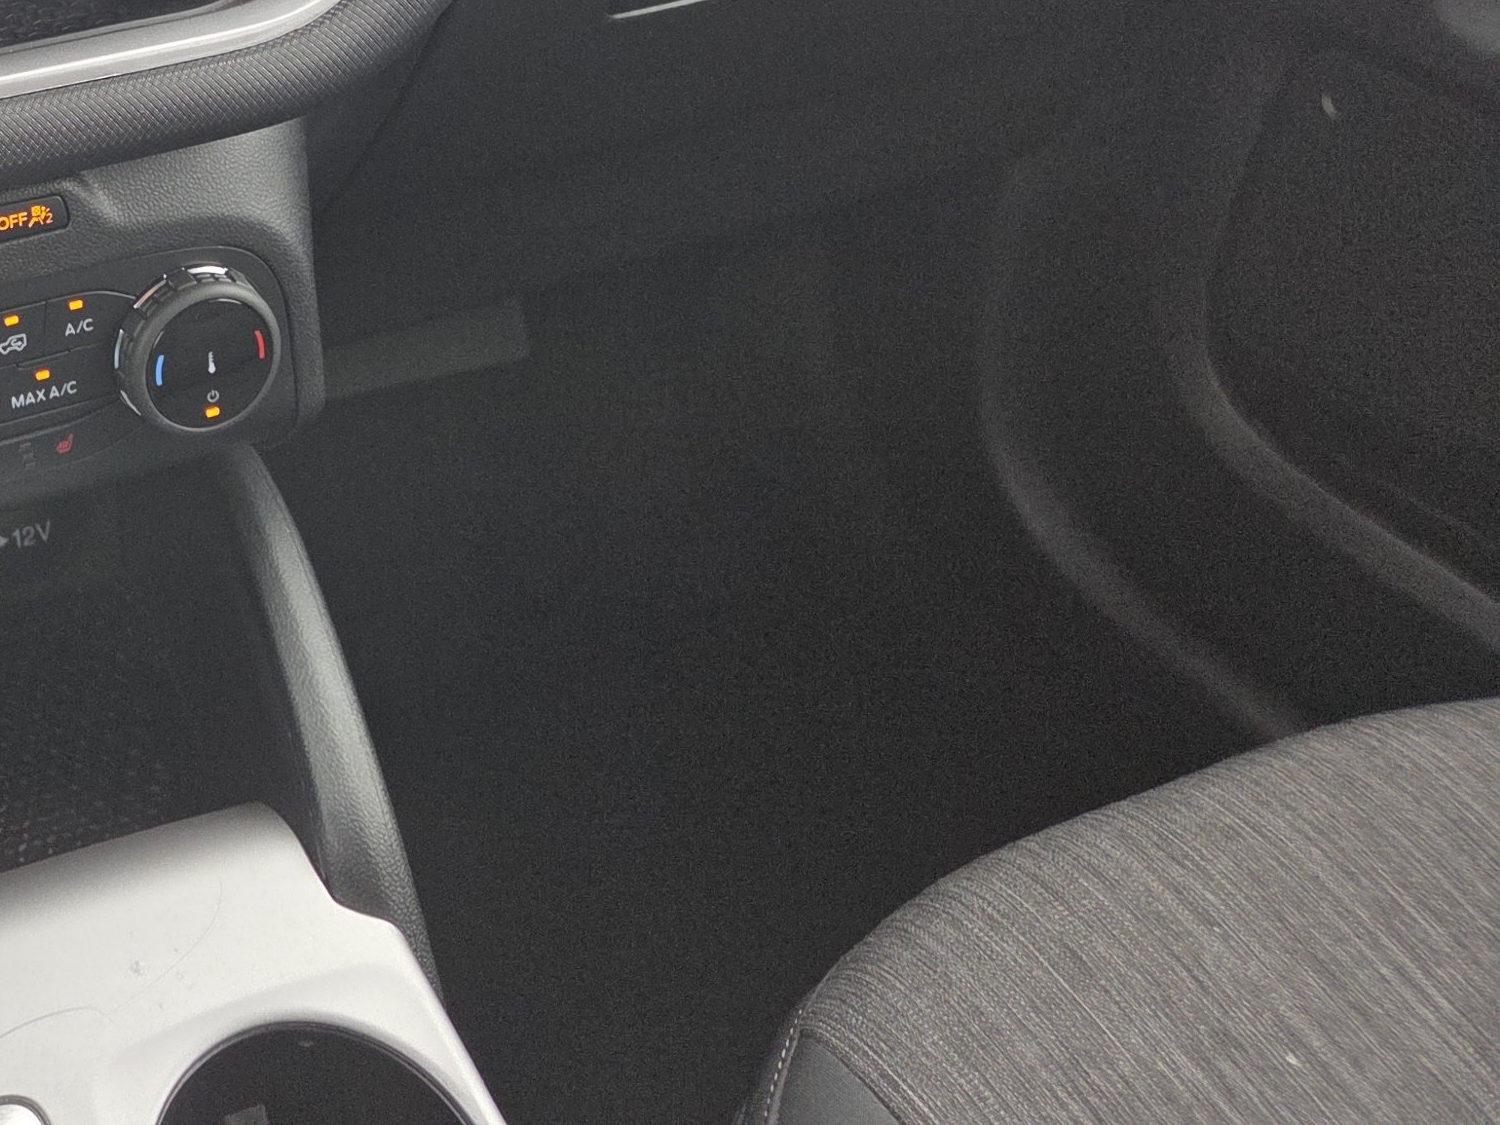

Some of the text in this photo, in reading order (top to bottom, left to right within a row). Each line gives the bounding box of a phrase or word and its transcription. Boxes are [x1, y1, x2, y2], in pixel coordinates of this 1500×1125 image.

[65, 318, 94, 337] A/C
[11, 380, 78, 410] MAX A/C
[12, 521, 52, 549] 12V
